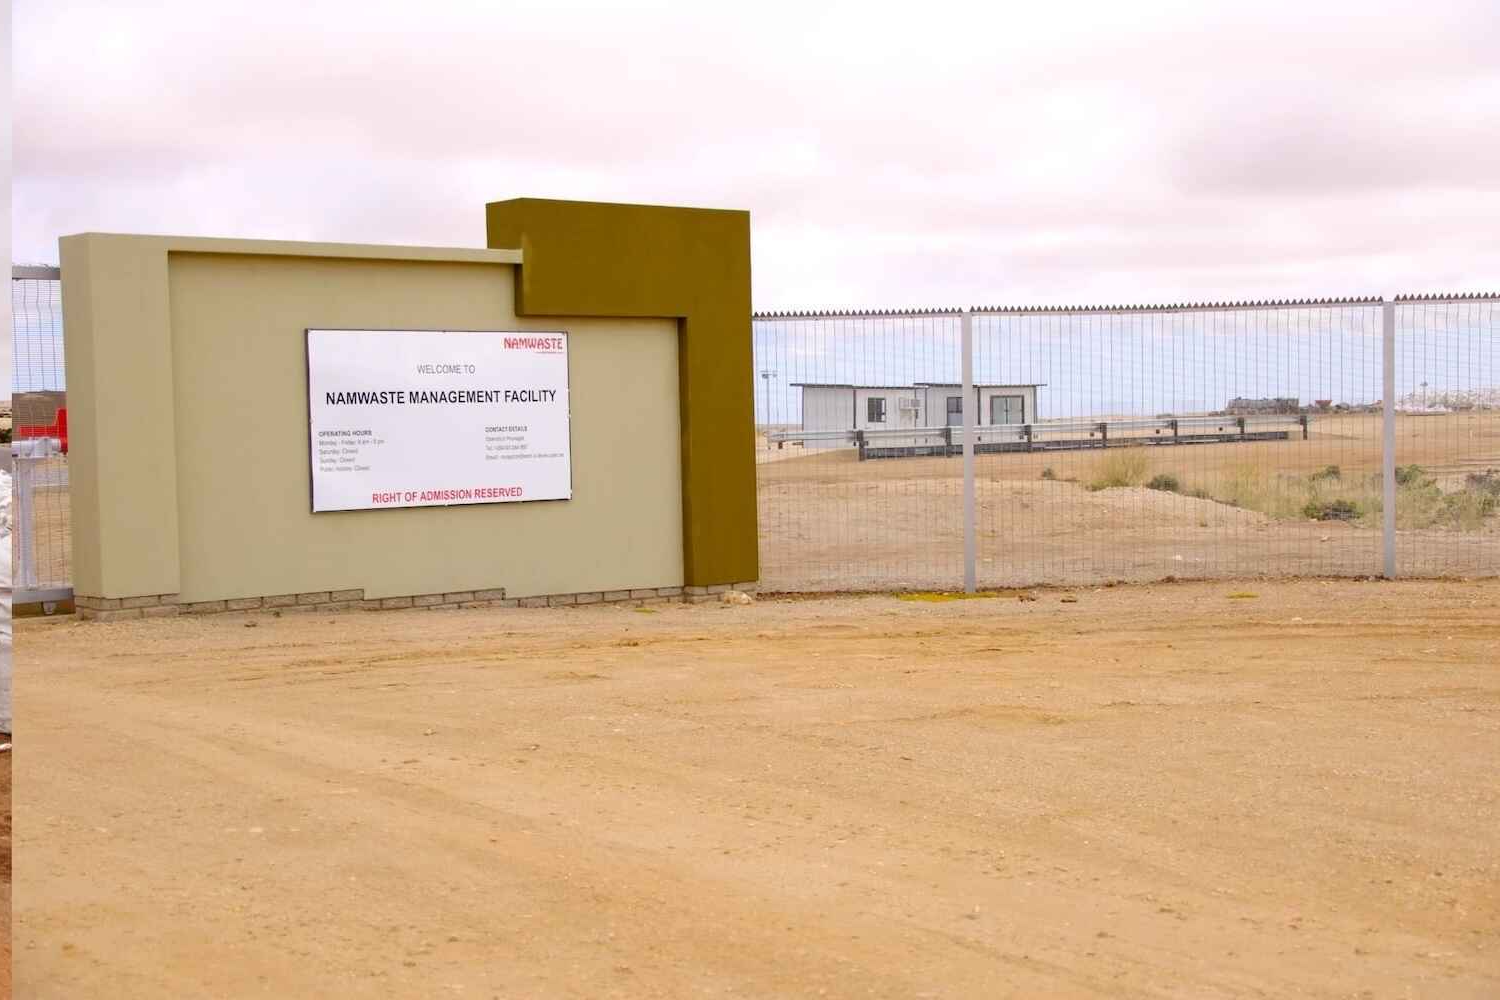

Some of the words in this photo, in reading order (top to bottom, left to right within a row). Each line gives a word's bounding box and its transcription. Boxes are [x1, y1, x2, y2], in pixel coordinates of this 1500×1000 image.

[503, 337, 563, 350] NAMWASTE
[417, 364, 461, 375] WELCOME
[463, 364, 476, 374] TO
[326, 391, 405, 405] NAMWASTE
[409, 390, 500, 404] MANAGEMENT
[504, 389, 557, 403] FACILITY
[372, 492, 402, 504] RIGHT
[404, 491, 418, 503] OF
[419, 489, 472, 502] ADMISSION
[474, 486, 524, 499] RESERVED
